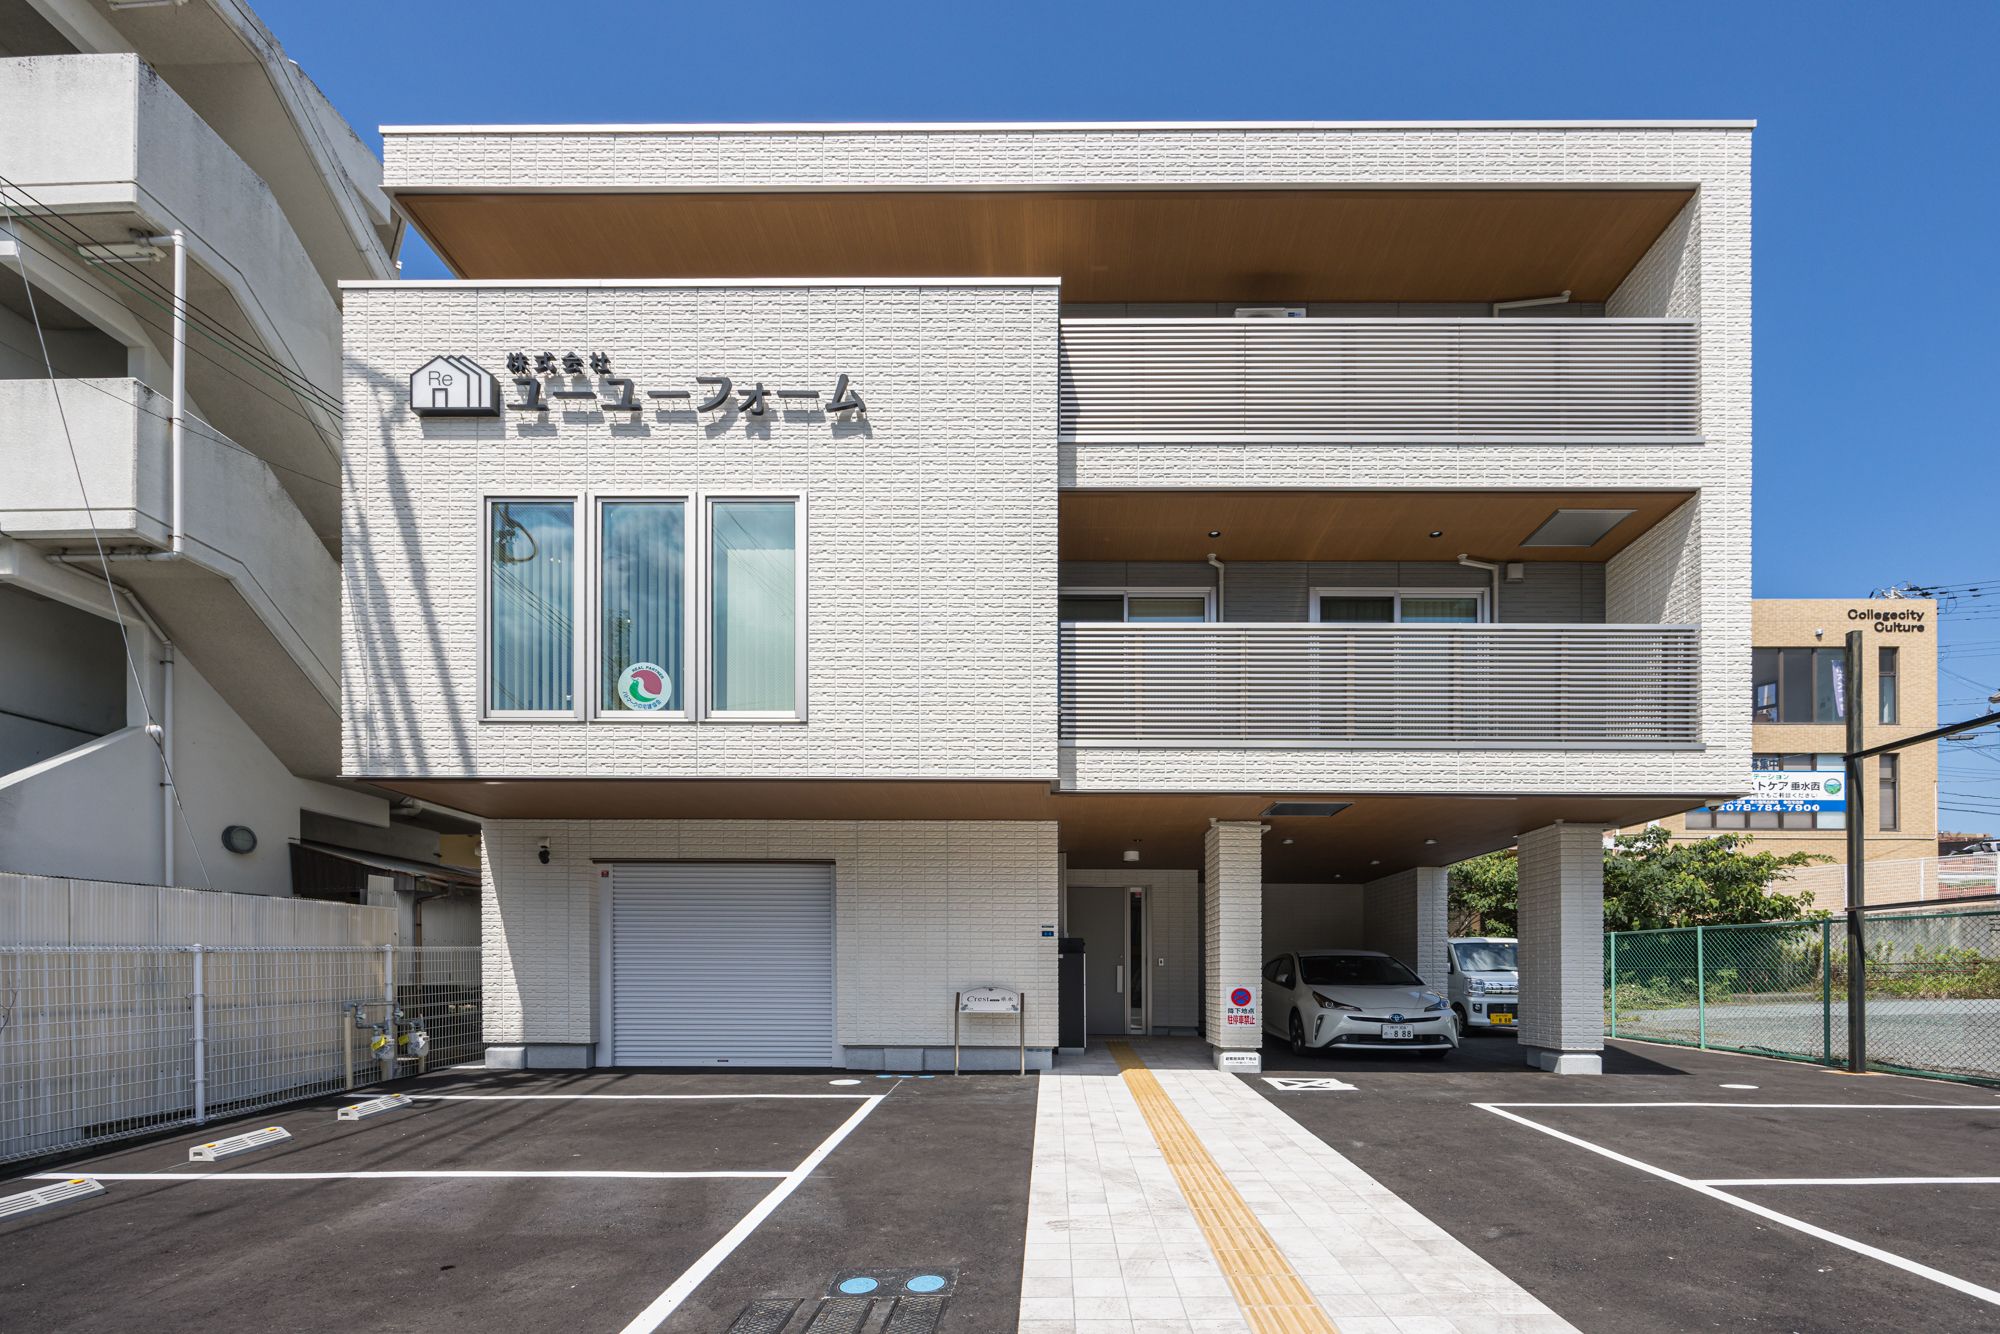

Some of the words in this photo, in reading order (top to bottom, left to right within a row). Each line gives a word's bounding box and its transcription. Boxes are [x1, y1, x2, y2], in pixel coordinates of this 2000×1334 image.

[507, 352, 613, 374] 株式会社
[428, 371, 453, 386] Re
[507, 374, 867, 416] ユーユーフォーム
[1847, 609, 1925, 621] Collegecity
[1874, 622, 1925, 632] Culture
[1228, 1015, 1255, 1025] 駐停車禁止
